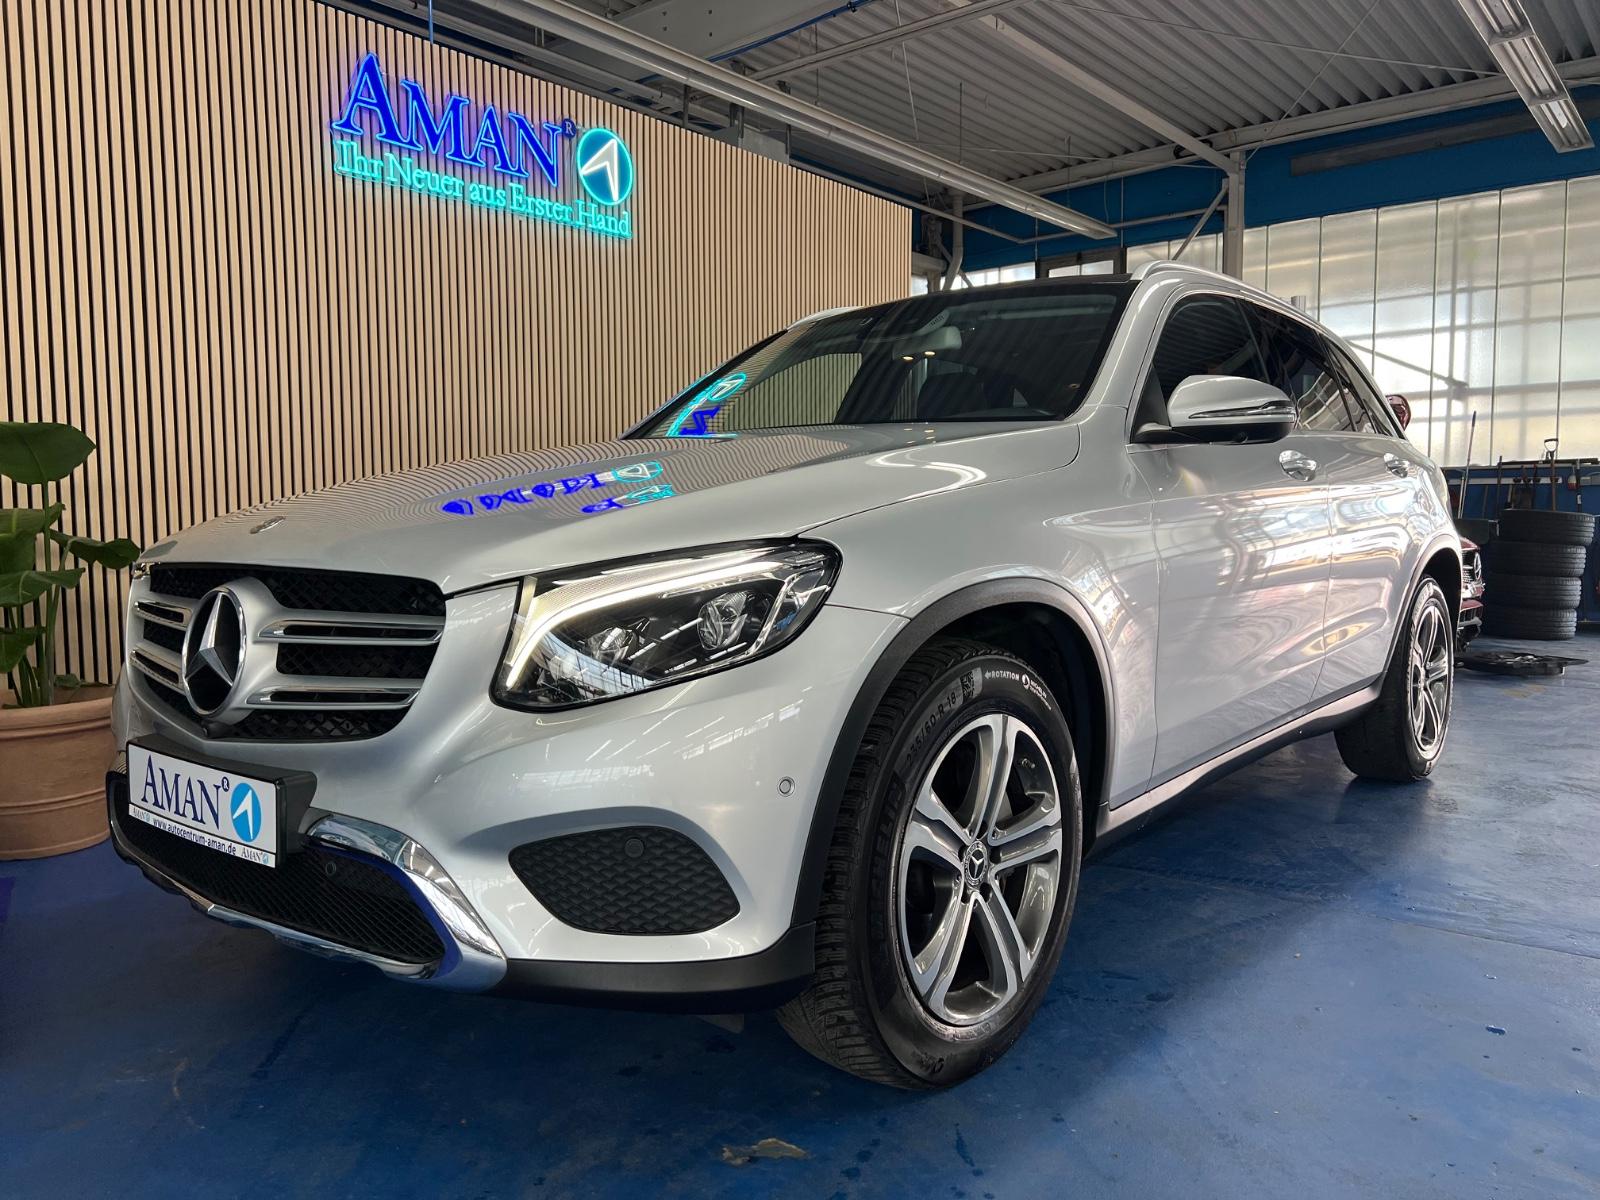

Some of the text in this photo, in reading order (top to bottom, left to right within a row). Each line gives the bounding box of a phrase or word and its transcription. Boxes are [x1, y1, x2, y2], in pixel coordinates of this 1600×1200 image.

[337, 139, 632, 237] Ihr Neuer aus Erster Hand
[991, 670, 1020, 681] ROTATION
[906, 691, 957, 764] 235/60 R 18
[152, 817, 237, 856] www.autocentrum-aman.de
